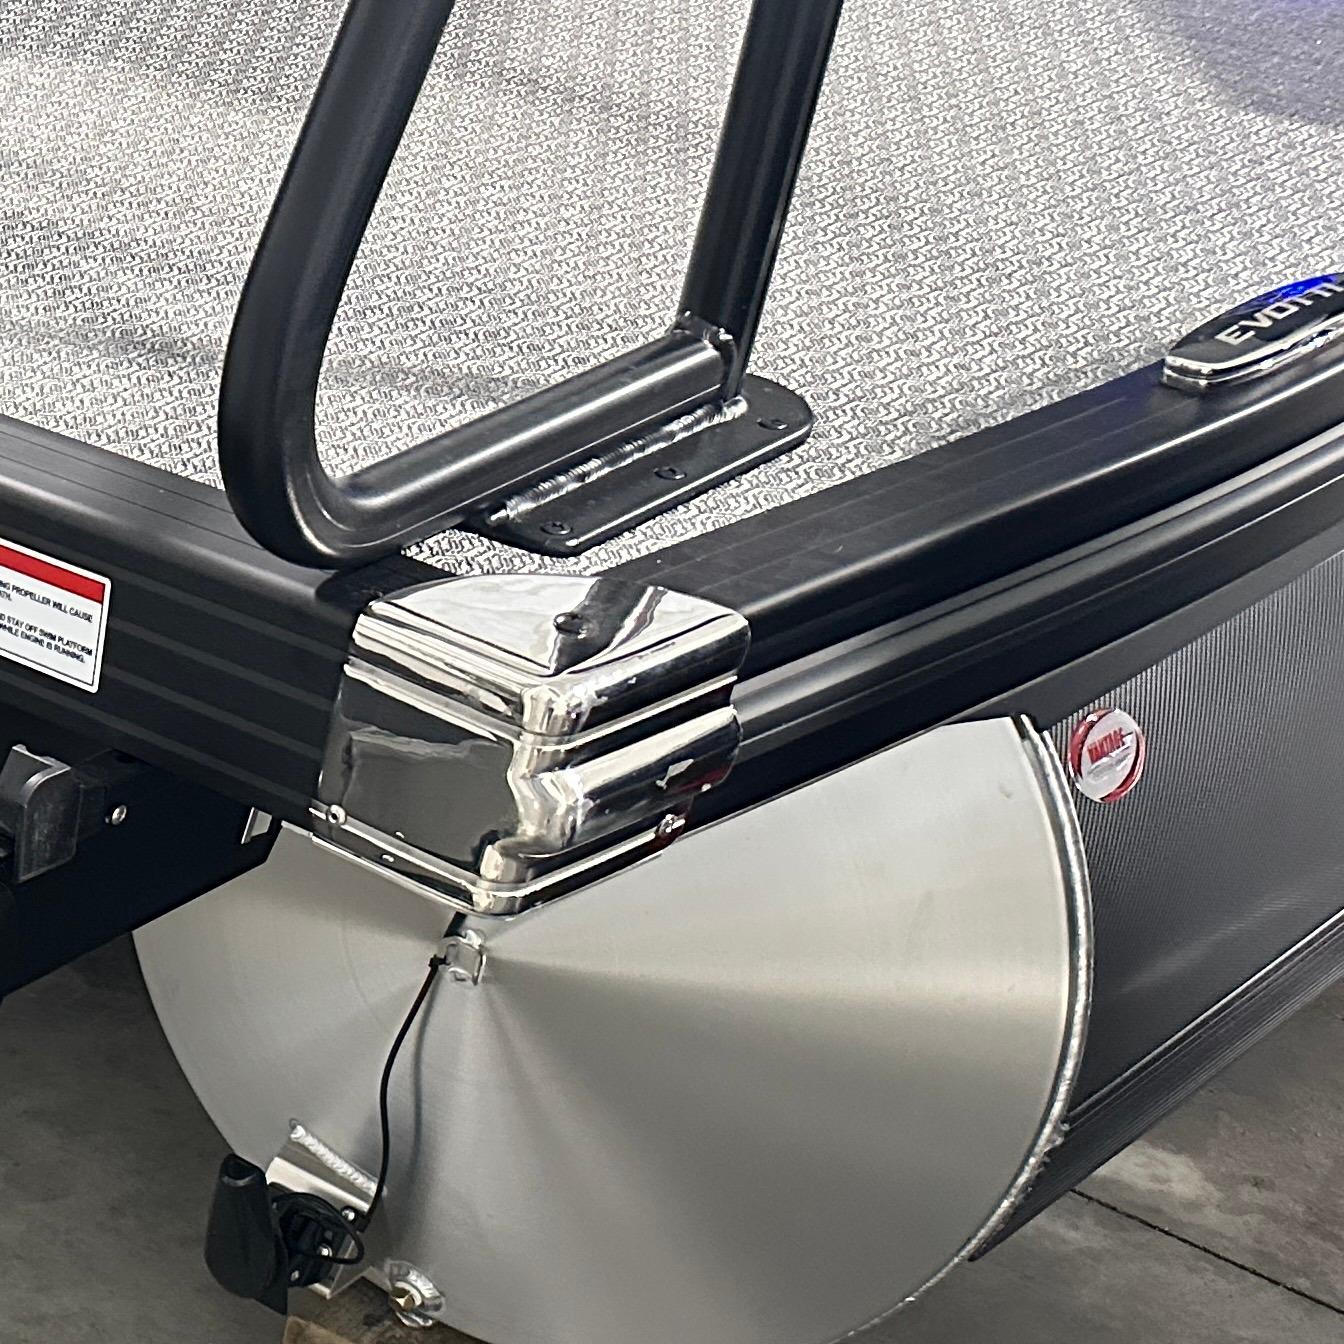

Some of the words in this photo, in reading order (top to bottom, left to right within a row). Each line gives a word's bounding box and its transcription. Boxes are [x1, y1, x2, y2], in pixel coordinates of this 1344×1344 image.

[11, 584, 50, 606] PROPELLER
[52, 600, 67, 613] WILL
[6, 615, 23, 629] STAY
[24, 622, 37, 634] OFF
[38, 628, 56, 642] SWIM
[57, 635, 92, 656] PLATFORM
[20, 630, 44, 647] ENGINE
[46, 640, 52, 650] IS
